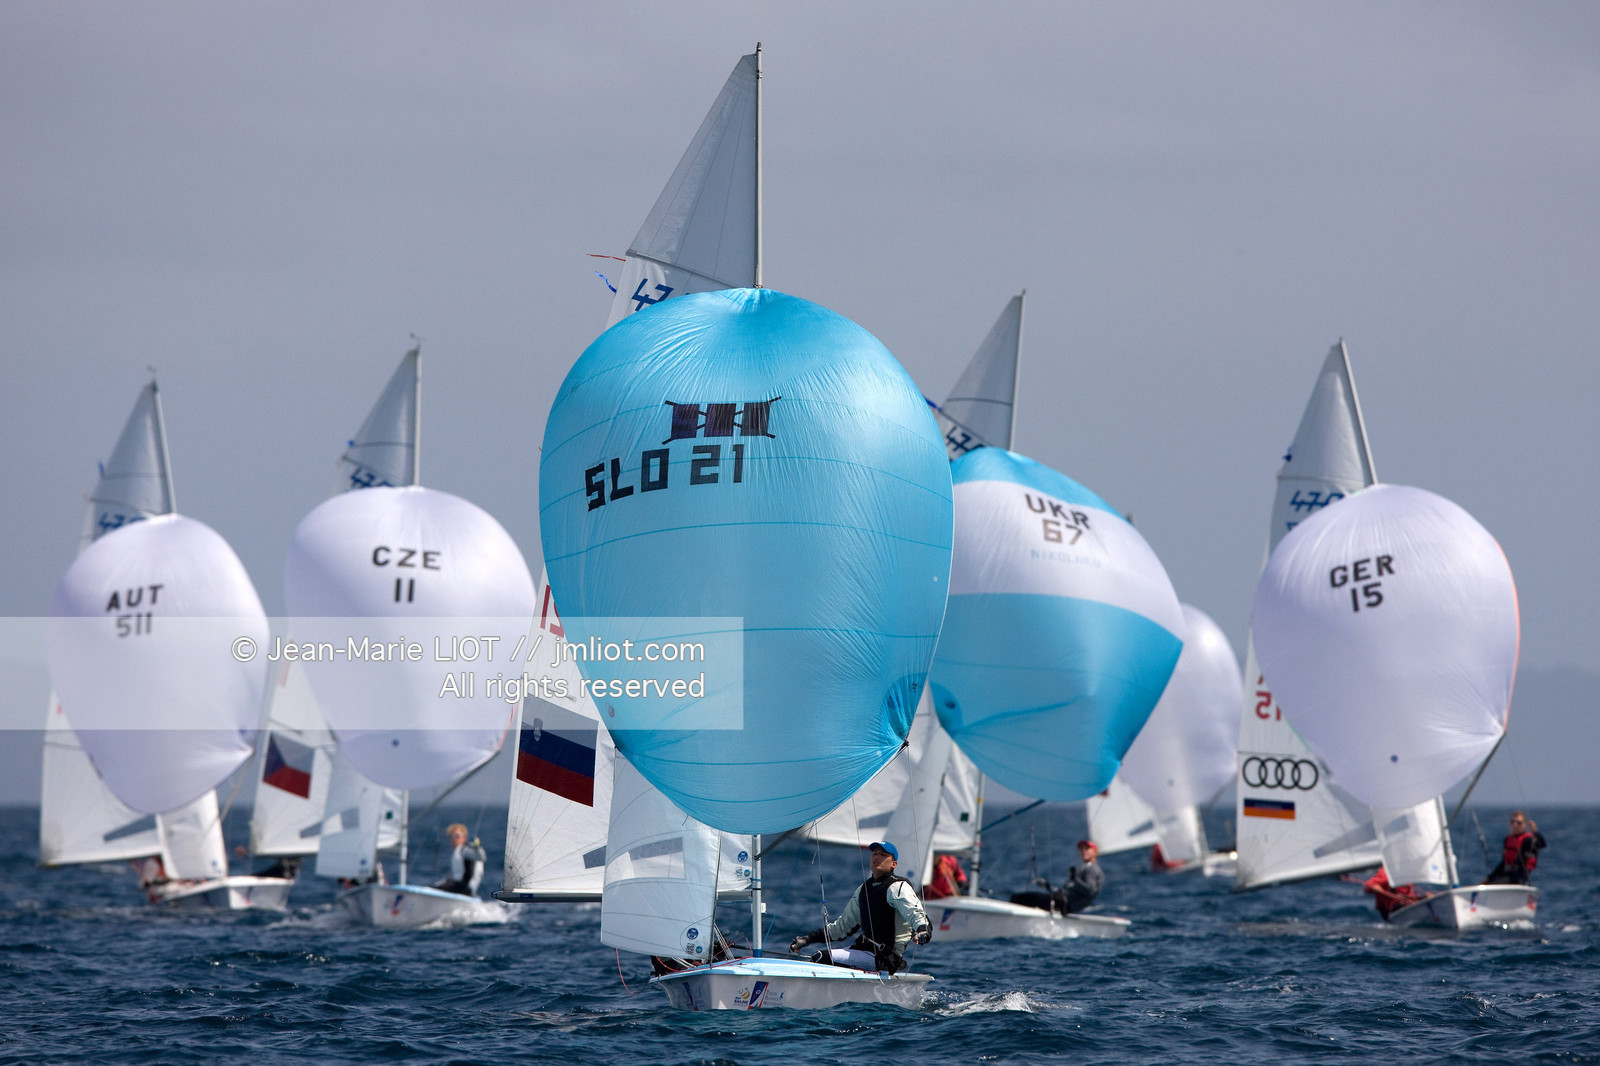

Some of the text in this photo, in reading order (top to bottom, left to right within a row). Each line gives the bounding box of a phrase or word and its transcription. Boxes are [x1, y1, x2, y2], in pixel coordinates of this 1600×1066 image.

[585, 444, 745, 512] SLO 21
[1025, 493, 1090, 530] UKR
[1042, 518, 1083, 545] 67
[372, 546, 442, 570] CZE
[1330, 554, 1396, 588] GER
[105, 584, 164, 612] AUT
[394, 577, 416, 603] 11
[1351, 582, 1384, 613] 15
[115, 612, 153, 638] 511
